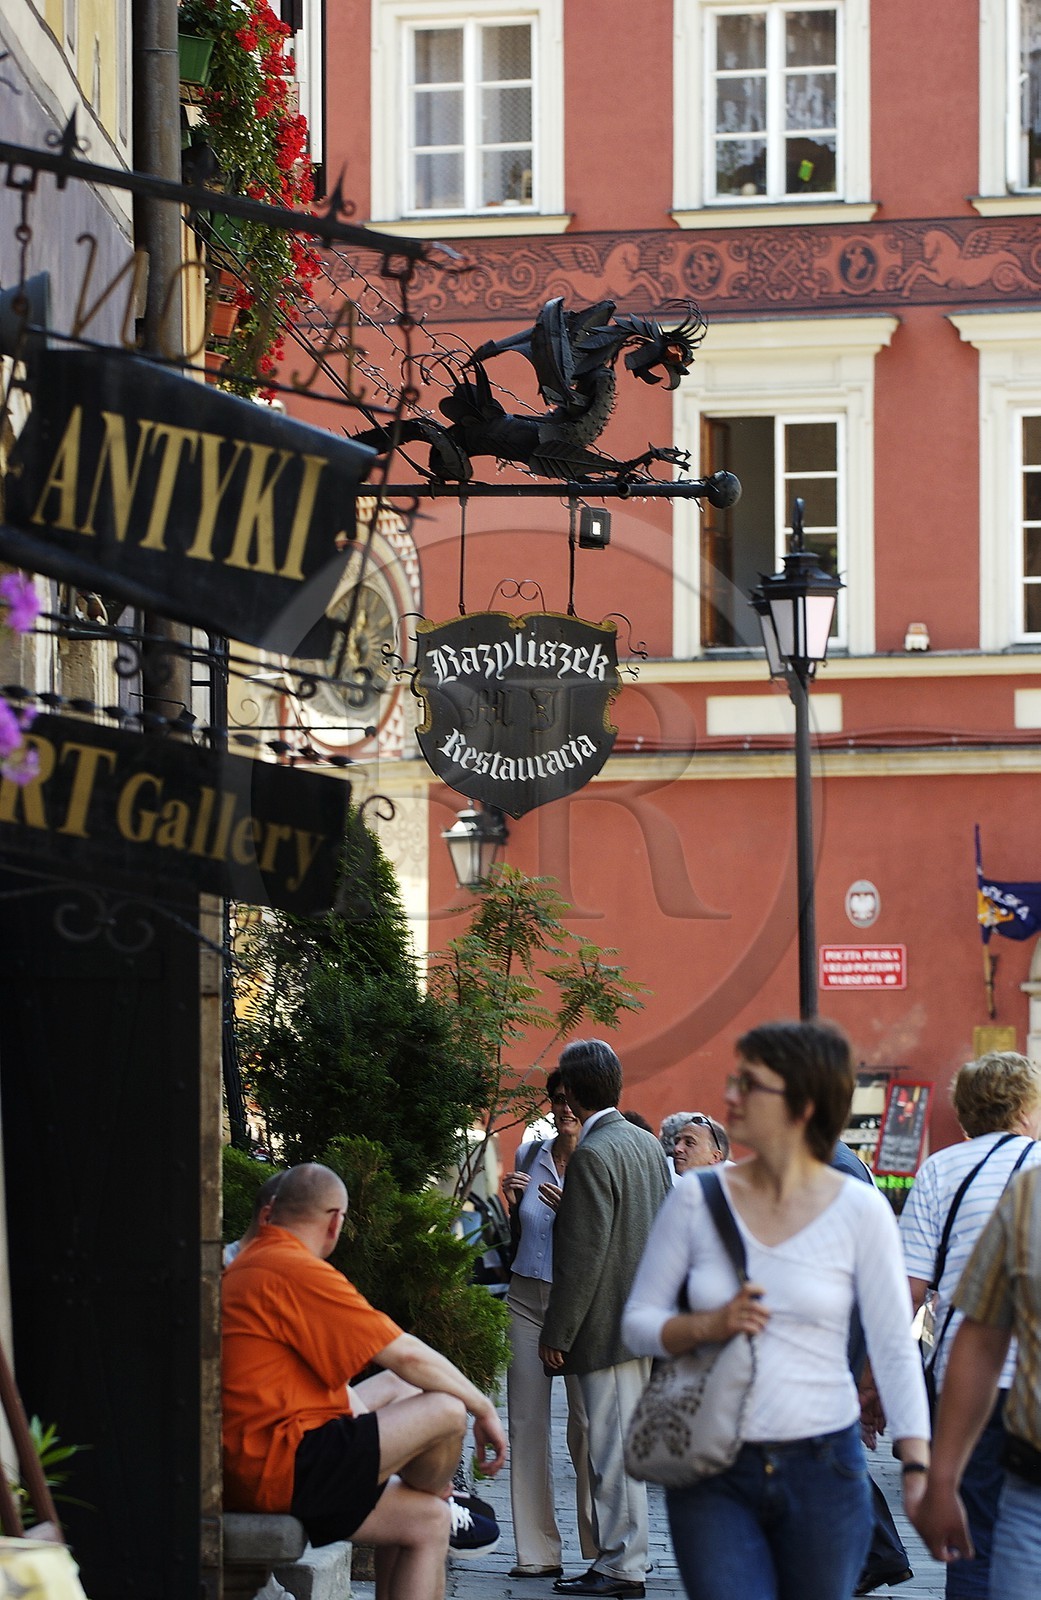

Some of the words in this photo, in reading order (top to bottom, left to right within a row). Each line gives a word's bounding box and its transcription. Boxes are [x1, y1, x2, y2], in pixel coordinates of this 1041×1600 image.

[31, 404, 329, 581] ANTYKI
[426, 631, 611, 687] Bazyliszek
[116, 772, 328, 893] Gallery
